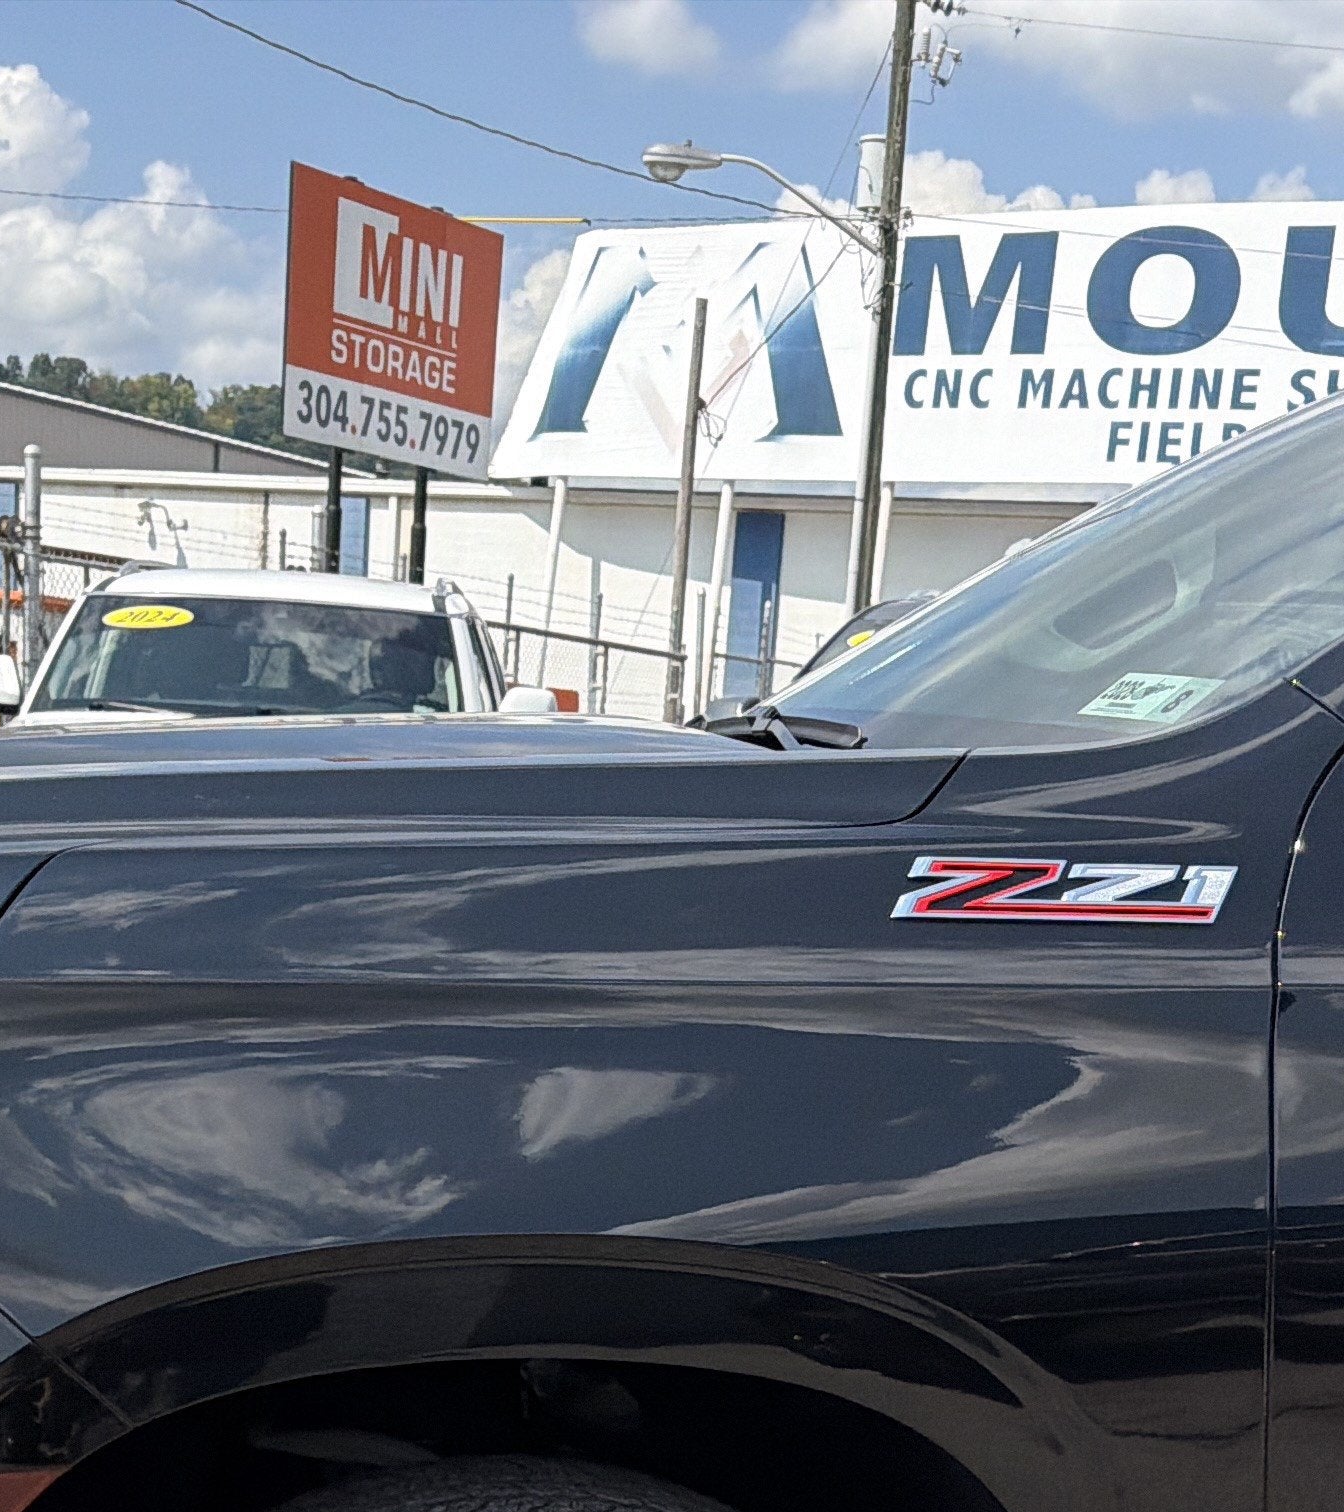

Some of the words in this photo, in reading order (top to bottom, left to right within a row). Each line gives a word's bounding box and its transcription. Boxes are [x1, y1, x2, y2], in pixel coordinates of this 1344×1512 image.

[336, 198, 463, 328] MINI
[331, 328, 457, 394] STORAGE
[397, 314, 458, 349] MALL
[297, 380, 480, 464] 304.755.7979
[903, 368, 994, 409] CNC
[1017, 368, 1260, 410] MACHINE
[116, 610, 180, 623] 2024
[890, 856, 1238, 923] Z71
